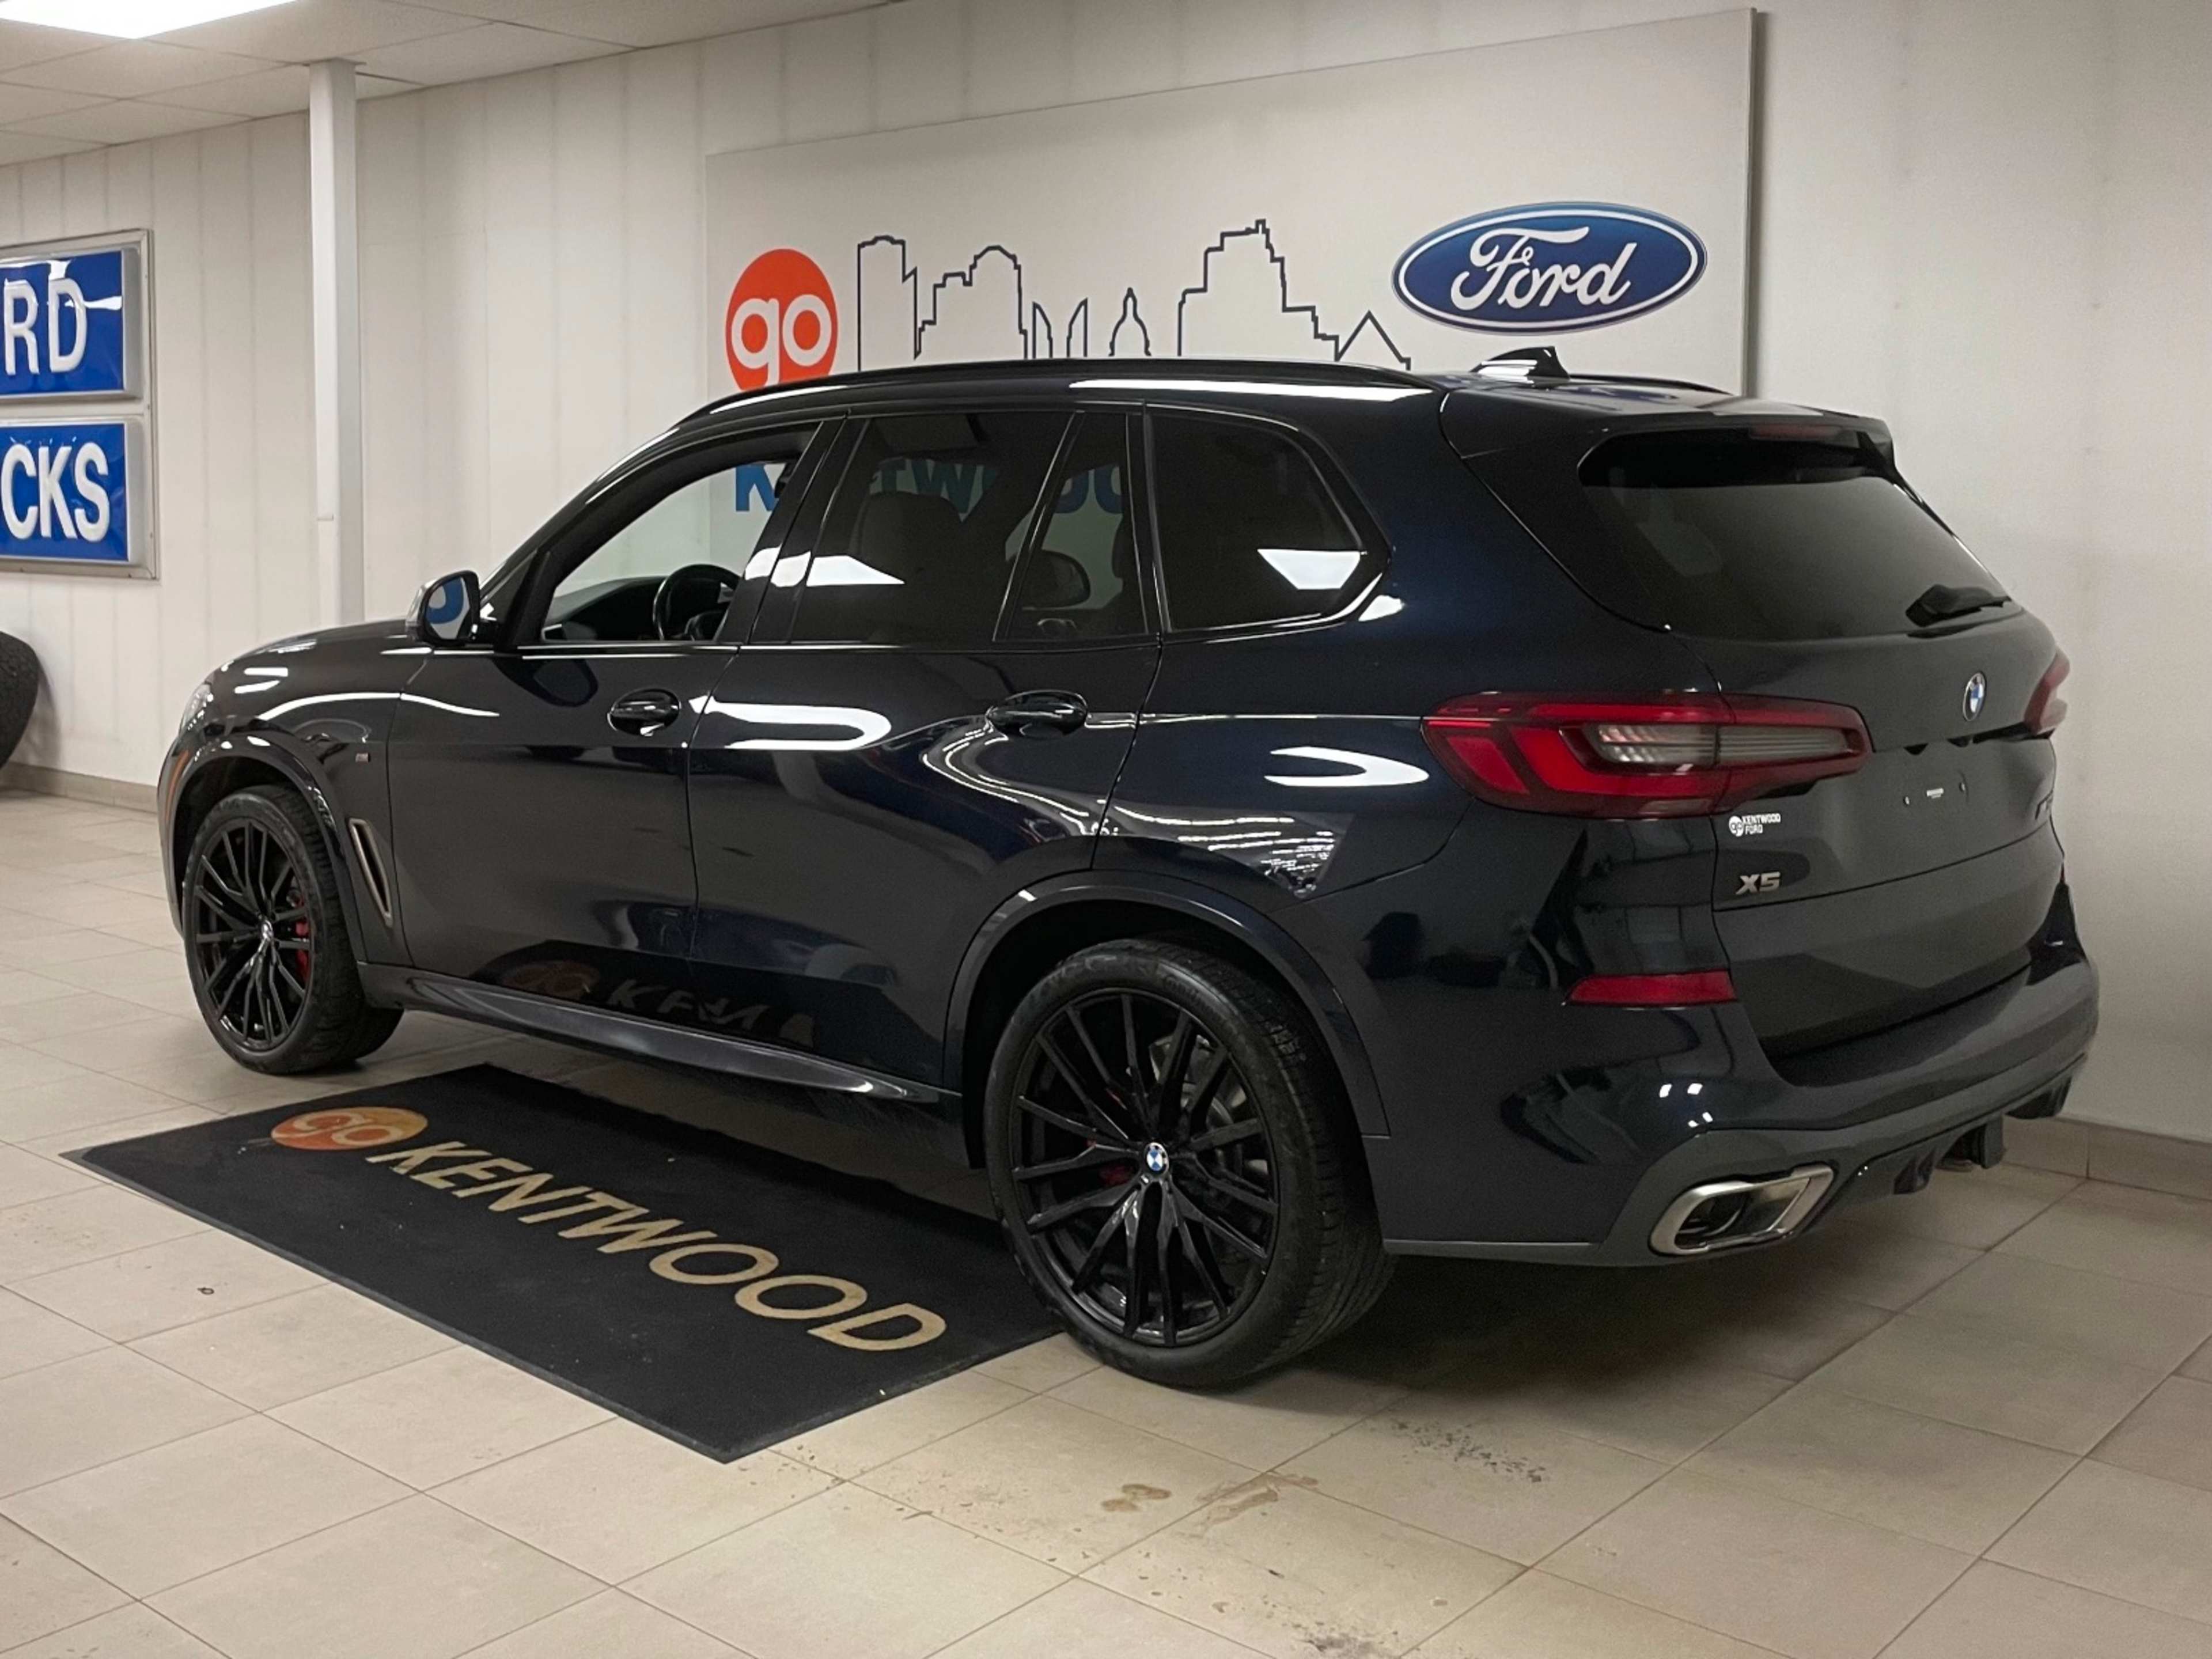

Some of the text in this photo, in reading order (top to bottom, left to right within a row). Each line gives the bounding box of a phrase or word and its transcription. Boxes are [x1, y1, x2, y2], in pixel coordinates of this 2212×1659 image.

[1451, 226, 1637, 310] Ford
[732, 294, 832, 387] go
[1742, 813, 1781, 824] KENTWOOD
[1745, 824, 1763, 835] FORD
[1735, 871, 1781, 895] X5
[272, 1112, 403, 1145] go
[365, 1142, 947, 1351] KENTWOOD
